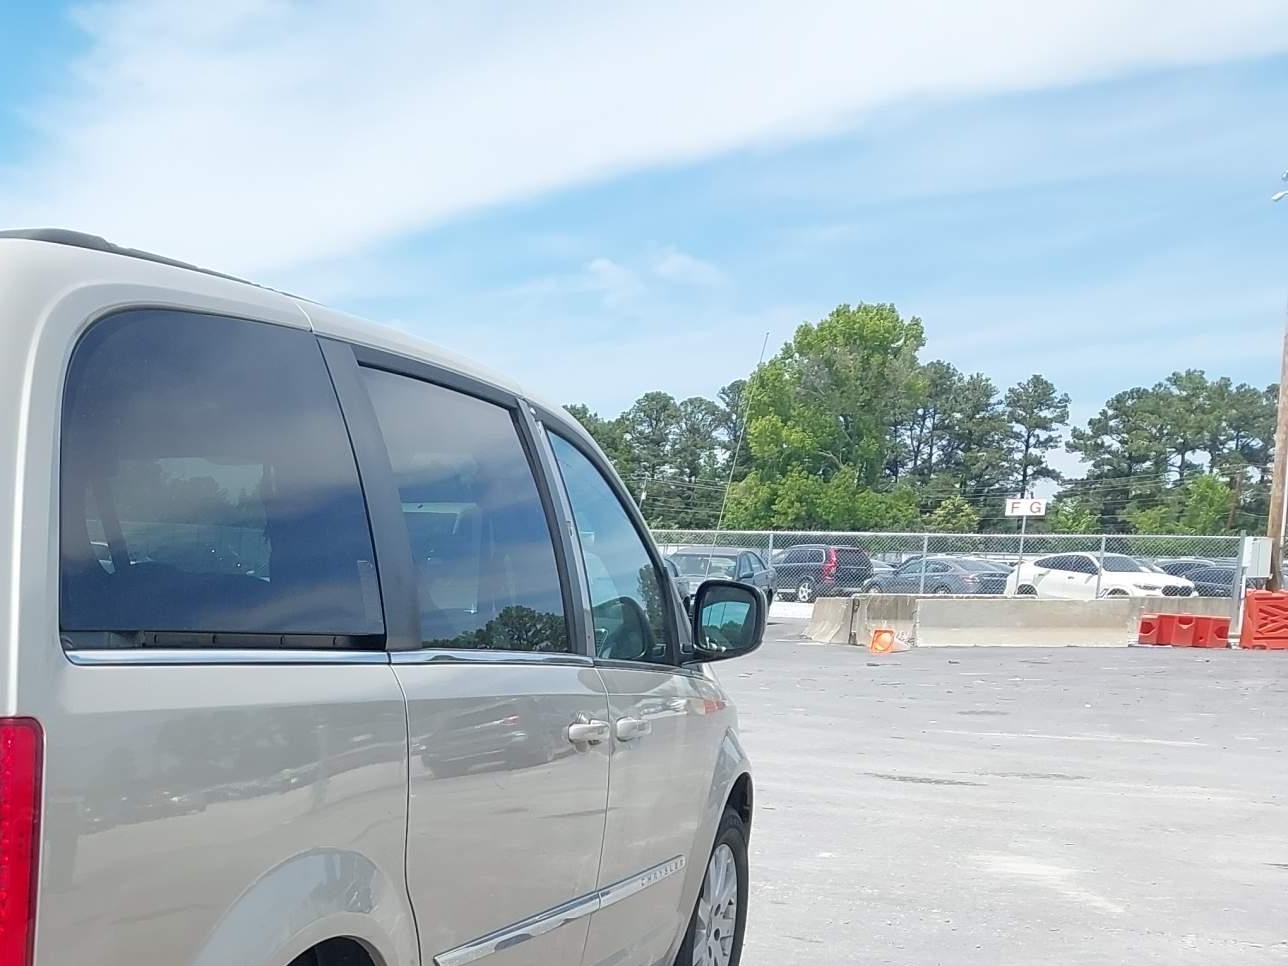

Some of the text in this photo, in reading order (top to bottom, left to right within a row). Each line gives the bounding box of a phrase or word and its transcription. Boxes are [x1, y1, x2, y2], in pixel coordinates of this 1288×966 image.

[1011, 501, 1042, 514] F G
[640, 858, 684, 887] CHRYSLER
